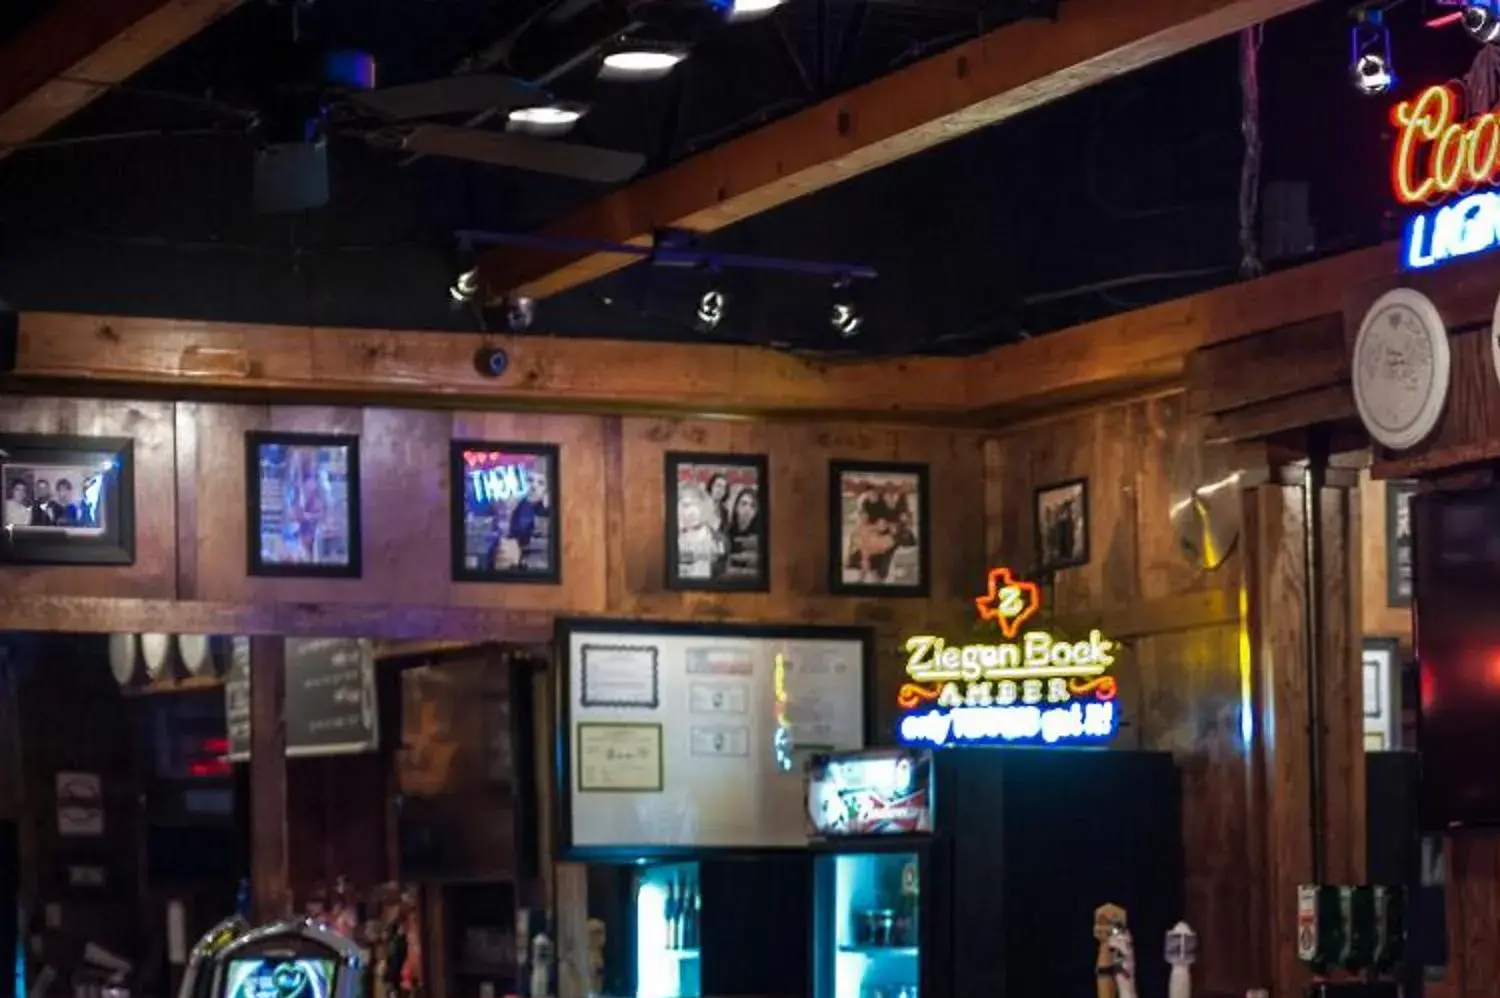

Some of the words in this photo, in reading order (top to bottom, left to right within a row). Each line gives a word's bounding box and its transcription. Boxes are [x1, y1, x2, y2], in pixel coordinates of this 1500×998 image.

[905, 635, 1020, 682] Ziegen
[1023, 629, 1115, 668] Bock
[937, 678, 1071, 707] AMBER
